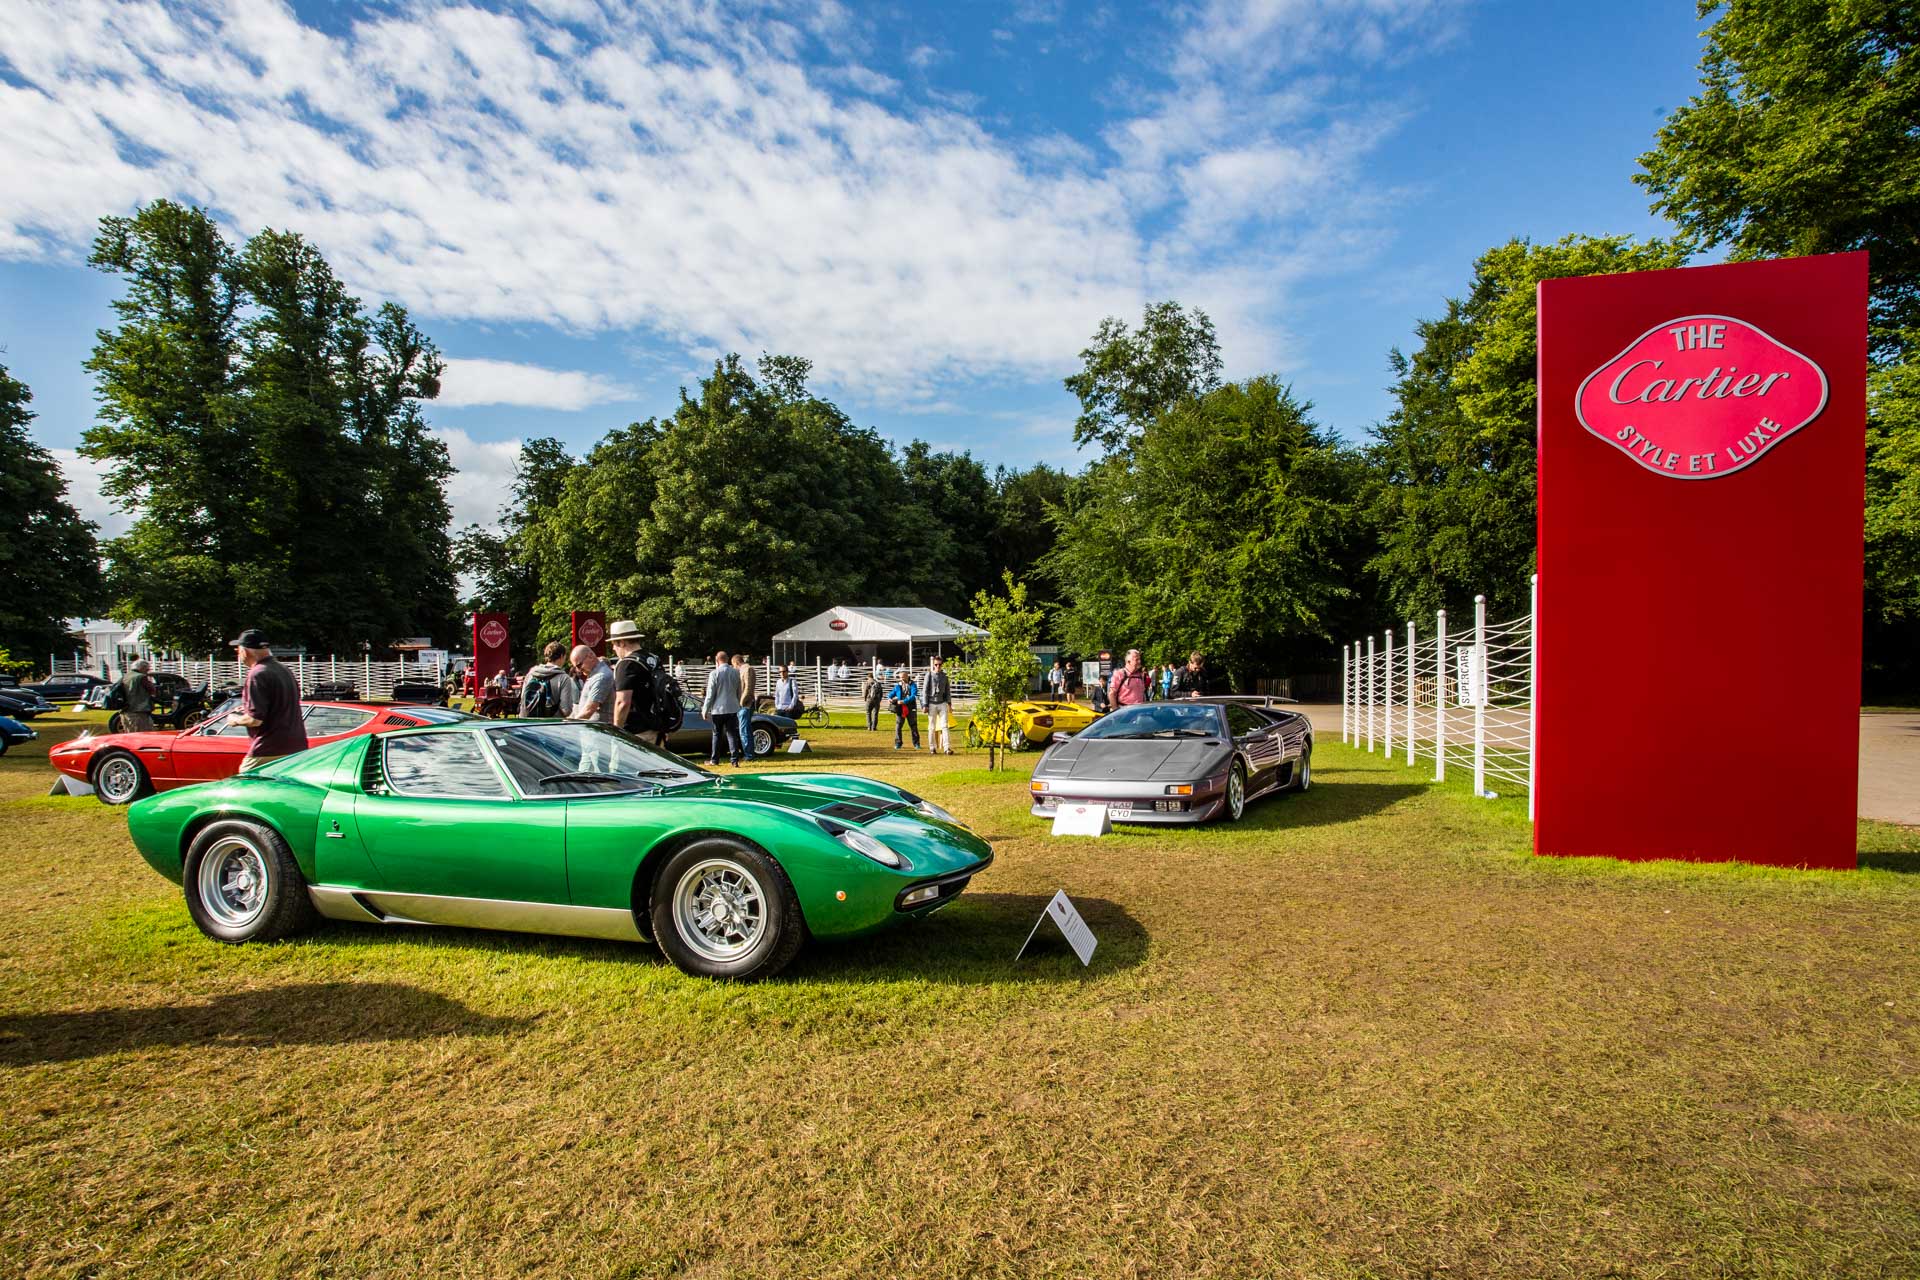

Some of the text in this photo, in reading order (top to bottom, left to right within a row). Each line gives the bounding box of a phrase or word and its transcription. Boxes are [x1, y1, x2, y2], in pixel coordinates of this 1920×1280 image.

[1669, 324, 1727, 351] THE
[1609, 359, 1790, 404] Cartier
[1616, 416, 1781, 473] STYLE ET LUXE
